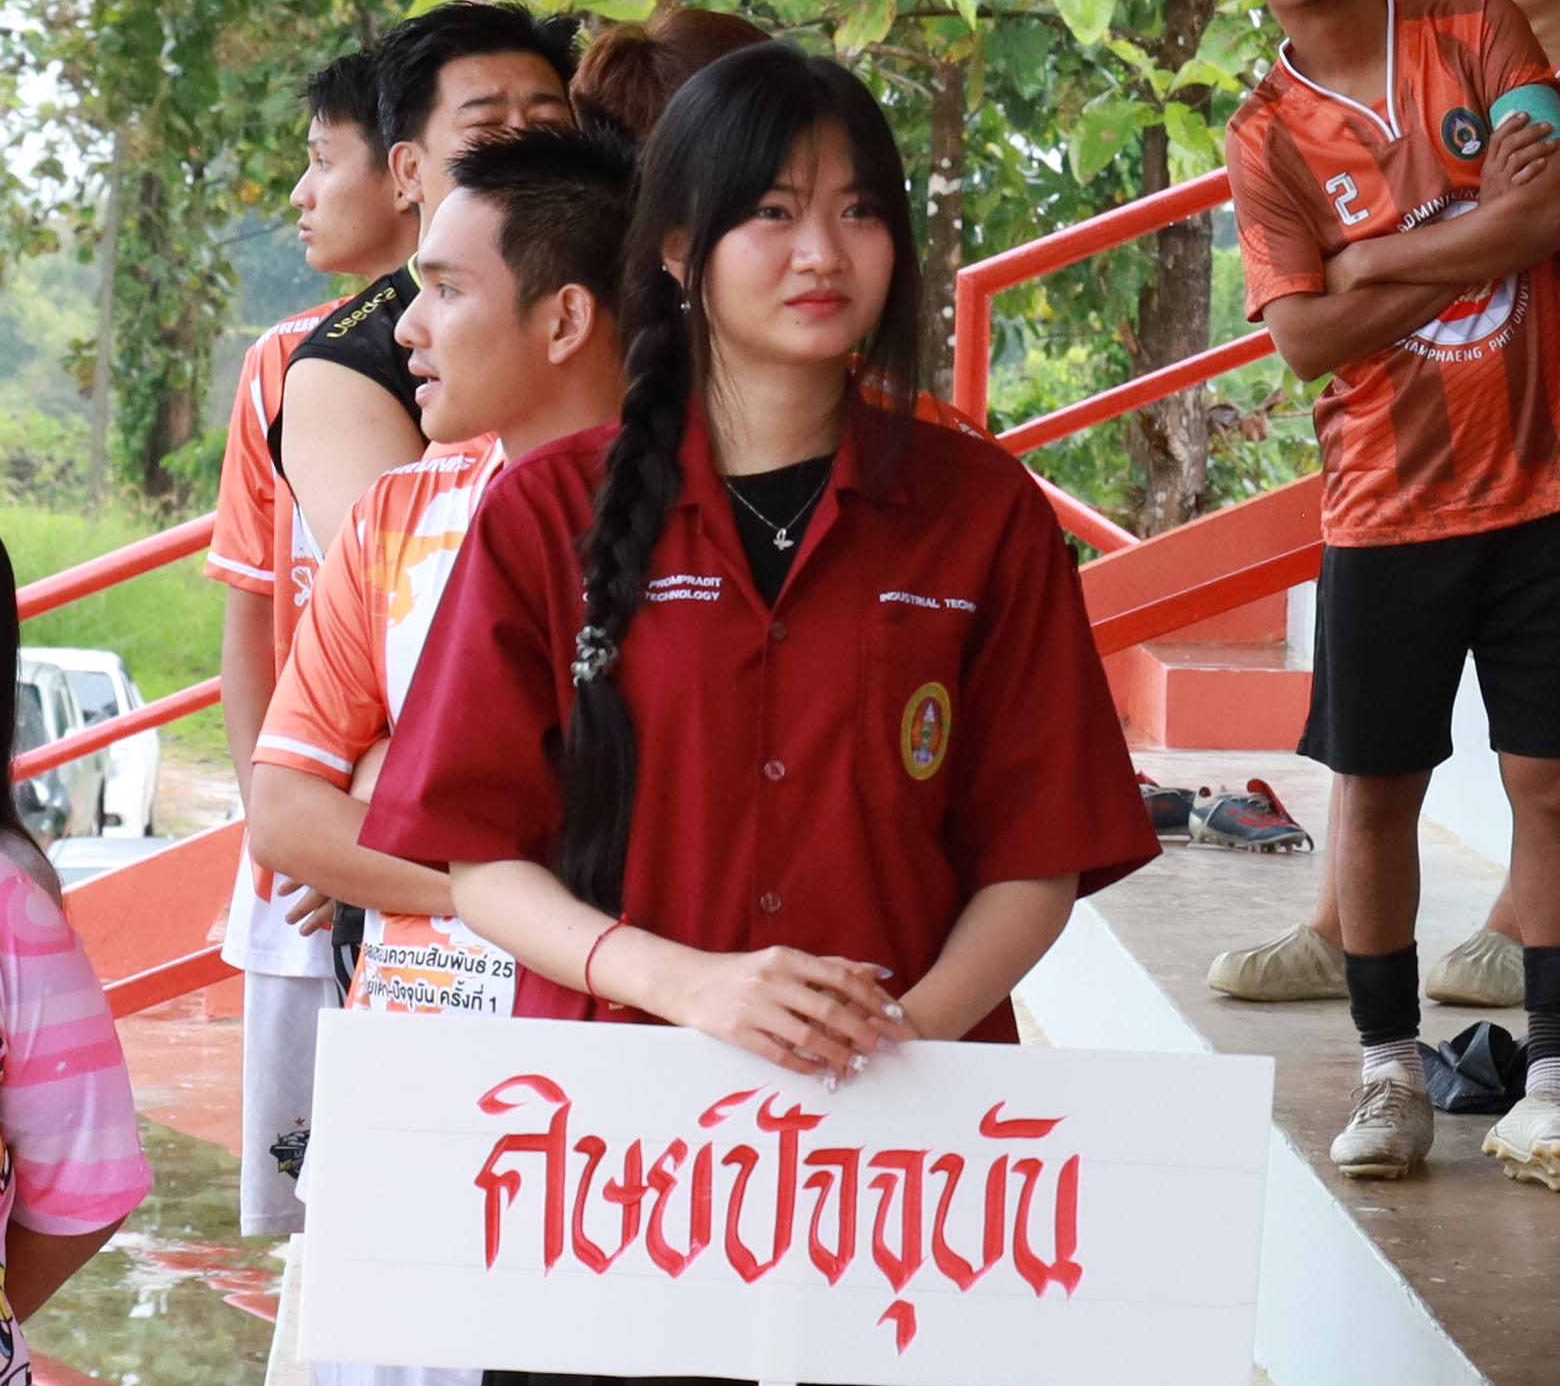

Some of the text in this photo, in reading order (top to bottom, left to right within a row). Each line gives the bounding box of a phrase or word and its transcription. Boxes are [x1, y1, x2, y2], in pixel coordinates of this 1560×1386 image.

[1325, 171, 1370, 226] 2
[645, 589, 720, 602] TECHNOLOGY
[490, 996, 497, 1013] 1
[474, 1074, 1083, 1355] ศิษย์ปัจจุบัน
